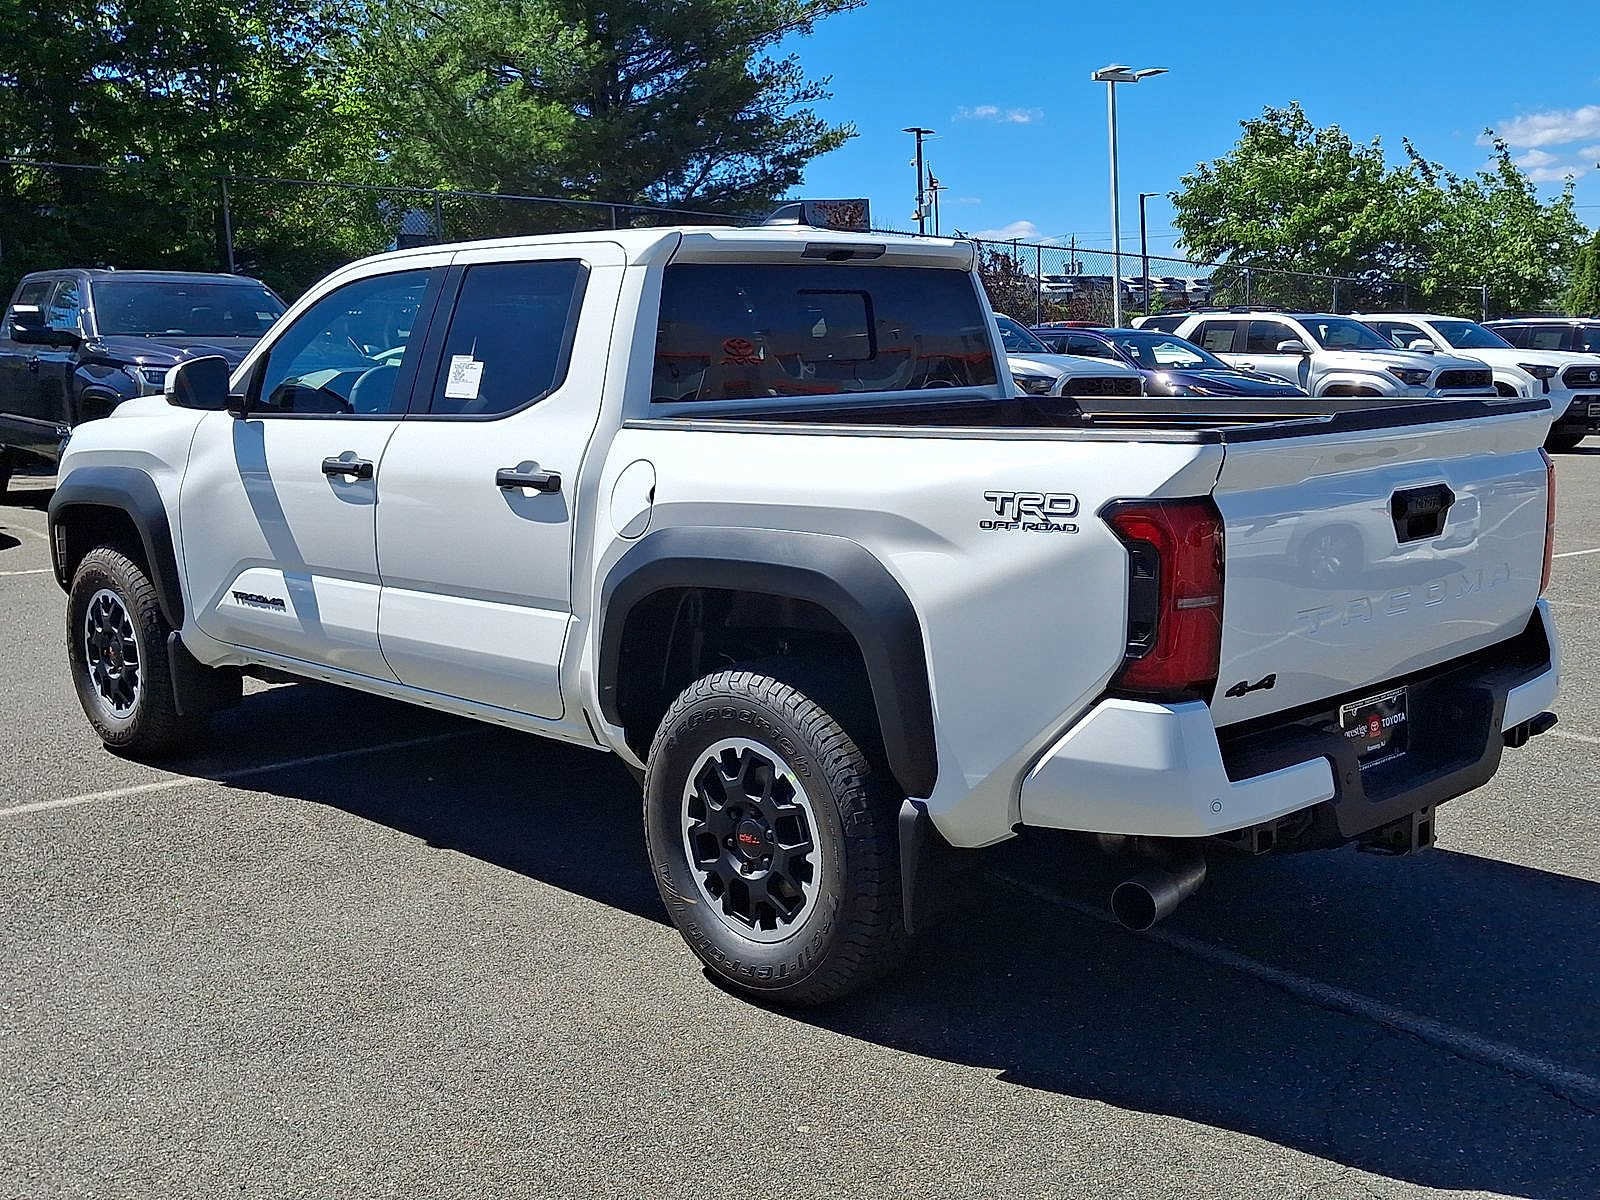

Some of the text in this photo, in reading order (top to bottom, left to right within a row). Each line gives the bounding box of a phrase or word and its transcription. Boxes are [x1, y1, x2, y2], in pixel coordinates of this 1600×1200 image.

[984, 491, 1079, 521] TRD
[979, 520, 1079, 534] OFF ROAD
[1297, 561, 1511, 635] TACOMA
[1381, 712, 1405, 727] TOYOTA
